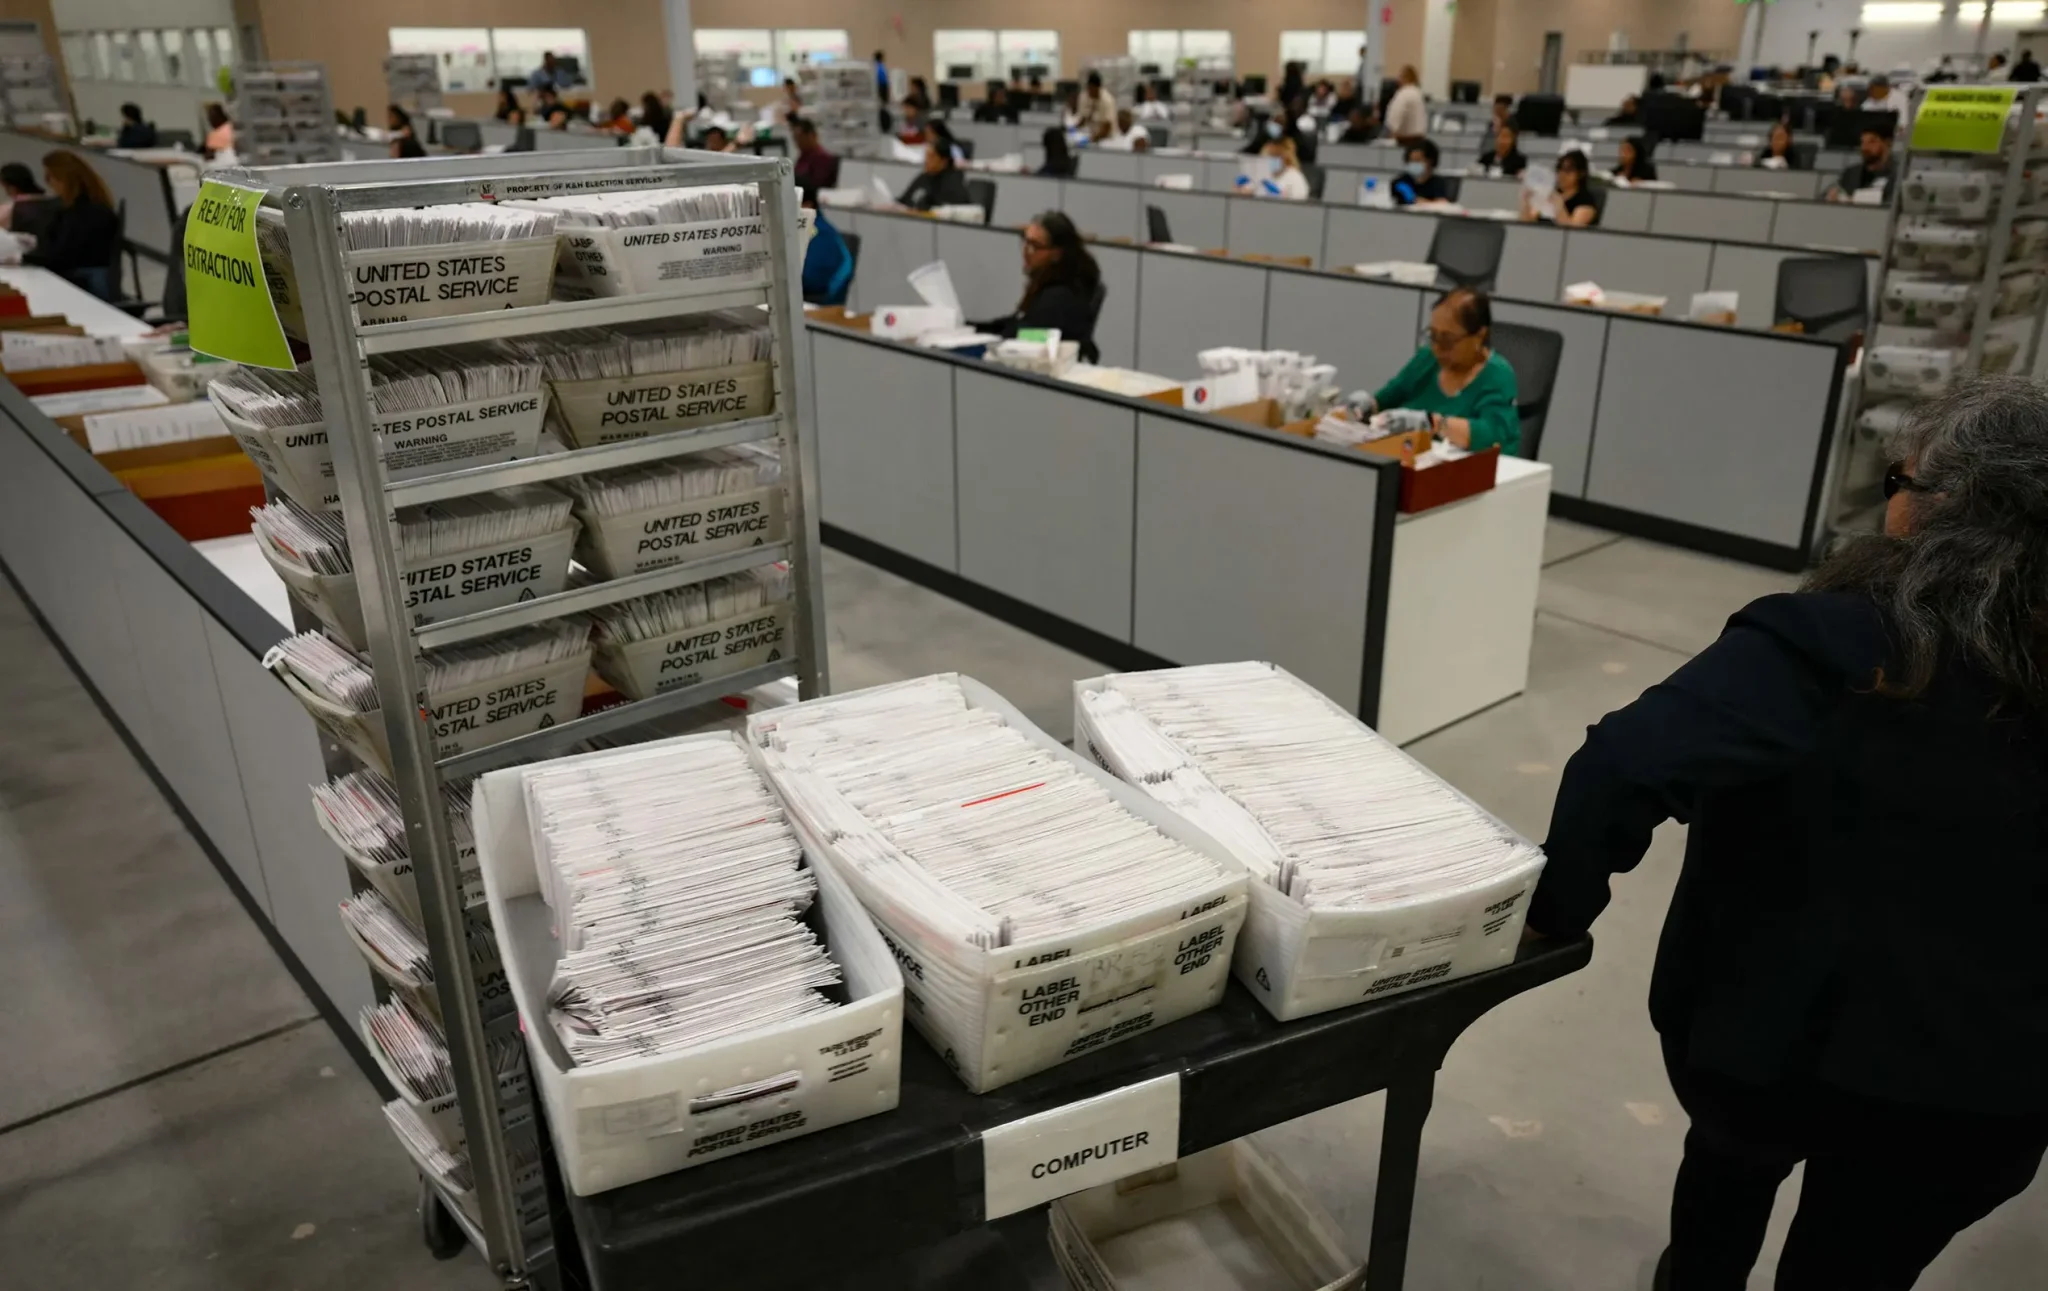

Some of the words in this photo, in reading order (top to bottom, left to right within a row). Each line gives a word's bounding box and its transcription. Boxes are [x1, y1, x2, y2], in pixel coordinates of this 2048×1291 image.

[506, 184, 551, 194] PROPERTY
[552, 183, 564, 192] OF
[585, 179, 624, 189] ELECTION
[625, 176, 663, 185] SERVICES
[197, 198, 229, 229] READY
[227, 205, 247, 233] FOR
[624, 232, 671, 247] UNITED
[673, 228, 717, 243] STATES
[720, 224, 766, 239] POSTAL
[702, 244, 742, 256] WARNING
[187, 244, 256, 288] EXTRACTION
[356, 262, 430, 284] UNITED
[437, 256, 506, 277] STATES
[351, 286, 430, 307] POSTAL
[437, 276, 519, 300] SERVICE
[361, 316, 408, 327] ARNING
[607, 386, 671, 406] UNITED
[676, 379, 738, 398] STATES
[416, 410, 475, 431] POSTAL
[479, 398, 538, 420] SERVICE
[601, 407, 670, 426] POSTAL
[676, 395, 748, 418] SERVICE
[286, 431, 329, 448] UNIT
[394, 434, 448, 449] WARNING
[644, 512, 702, 535] UNITED
[706, 501, 761, 523] STATES
[638, 533, 699, 554] POSTAL
[705, 515, 769, 540] SERVICE
[461, 547, 532, 574] STATES
[461, 564, 542, 595] SERVICE
[666, 630, 721, 655] UNITED
[725, 615, 776, 640] STATES
[660, 649, 718, 673] POSTAL
[724, 628, 784, 656] SERVICE
[486, 678, 546, 705] STATES
[486, 690, 557, 724] SERVICE
[1174, 936, 1223, 965] OTHER
[1178, 925, 1225, 952] LABEL
[1180, 954, 1211, 975] END
[1372, 972, 1412, 987] UNITED
[1411, 961, 1452, 978] STATES
[1022, 976, 1081, 1000] LABEL
[1362, 981, 1404, 996] POSTAL
[1405, 967, 1452, 985] SERVICE
[1019, 990, 1080, 1015] OTHER
[1029, 1007, 1066, 1027] END
[687, 1136, 743, 1158] POSTAL
[746, 1117, 807, 1141] SERVICE
[694, 1125, 747, 1147] UNITED
[749, 1110, 802, 1131] STATES
[1030, 1131, 1149, 1179] COMPUTER
